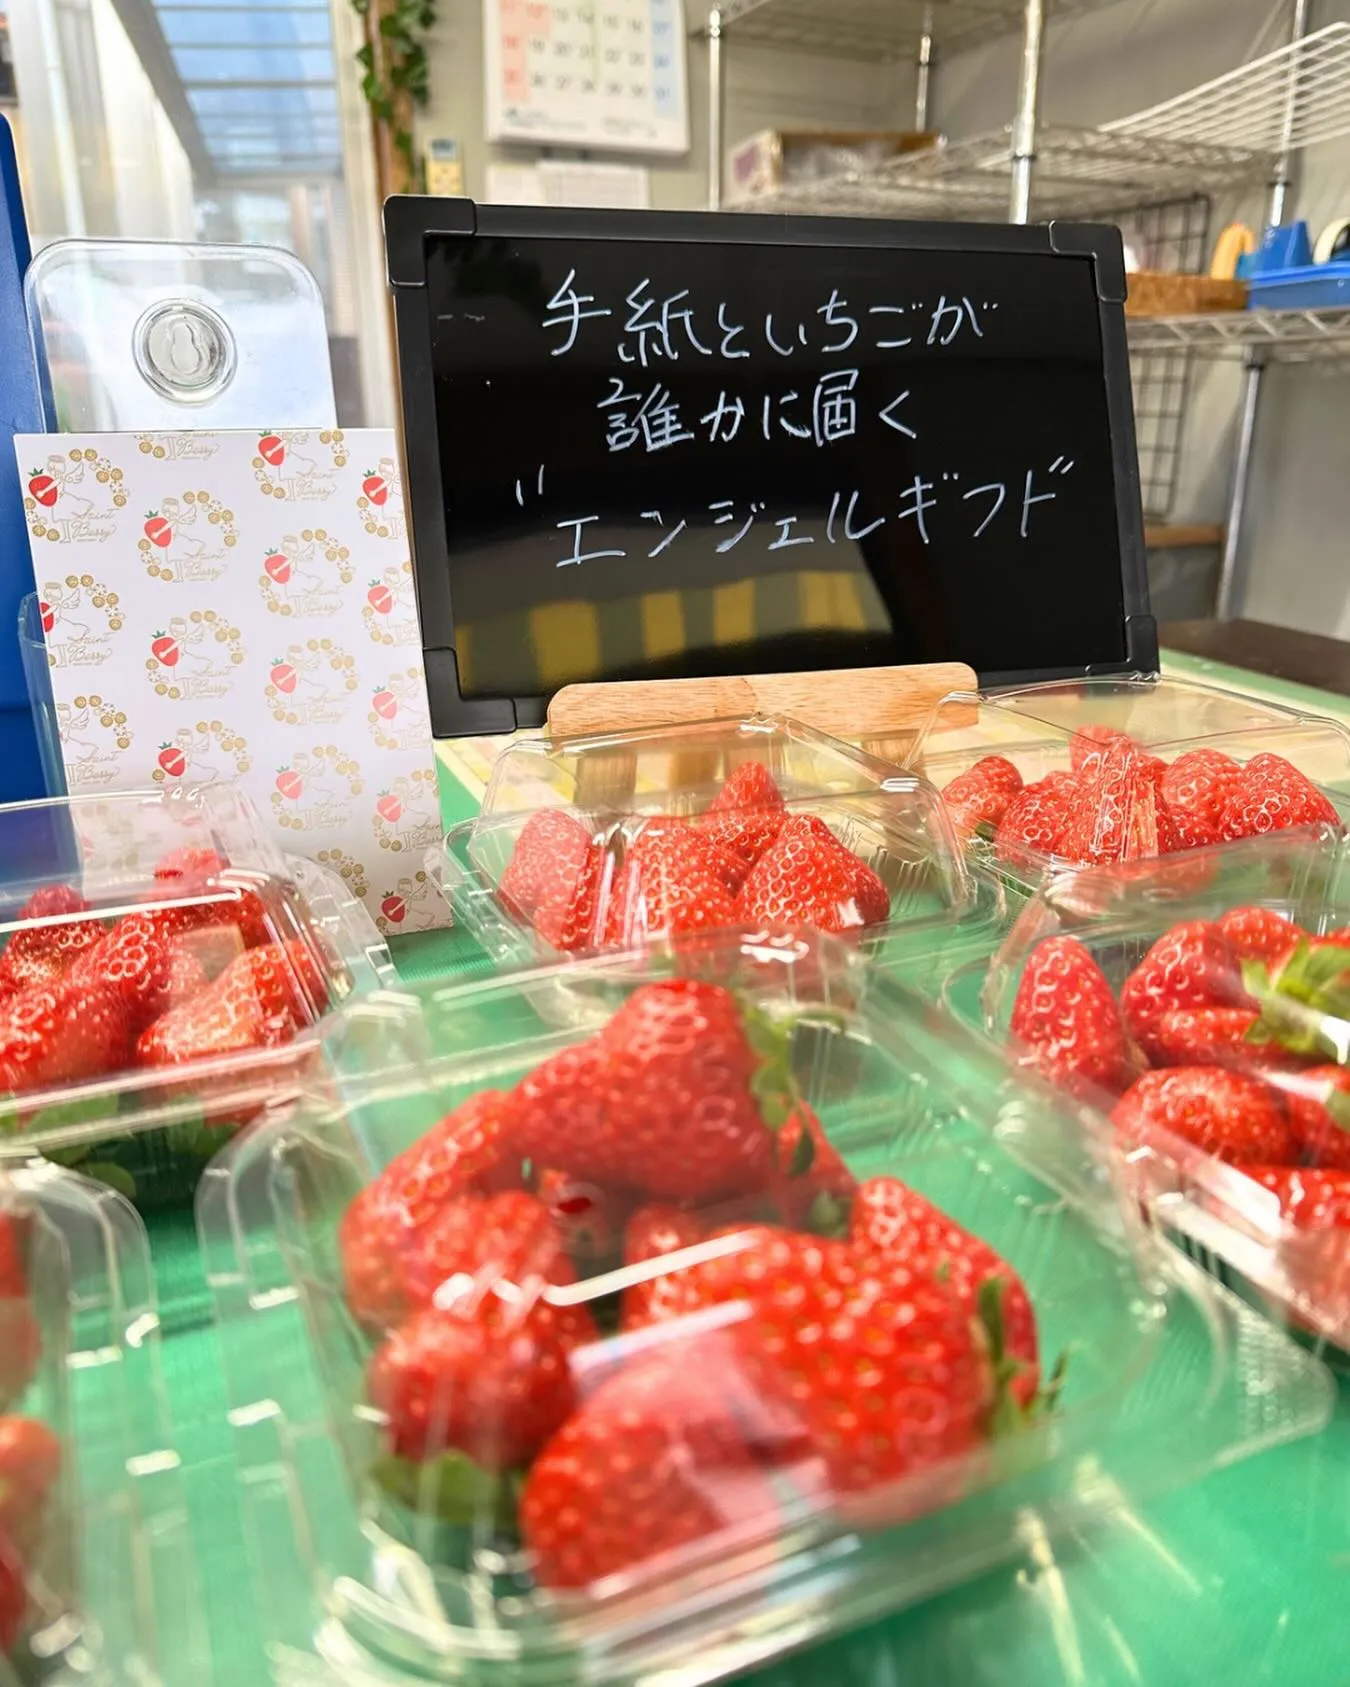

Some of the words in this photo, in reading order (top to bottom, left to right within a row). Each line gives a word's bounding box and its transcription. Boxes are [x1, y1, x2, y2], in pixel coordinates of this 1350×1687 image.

[543, 269, 997, 366] 手紙といちごが
[598, 369, 916, 451] 誰かに届く
